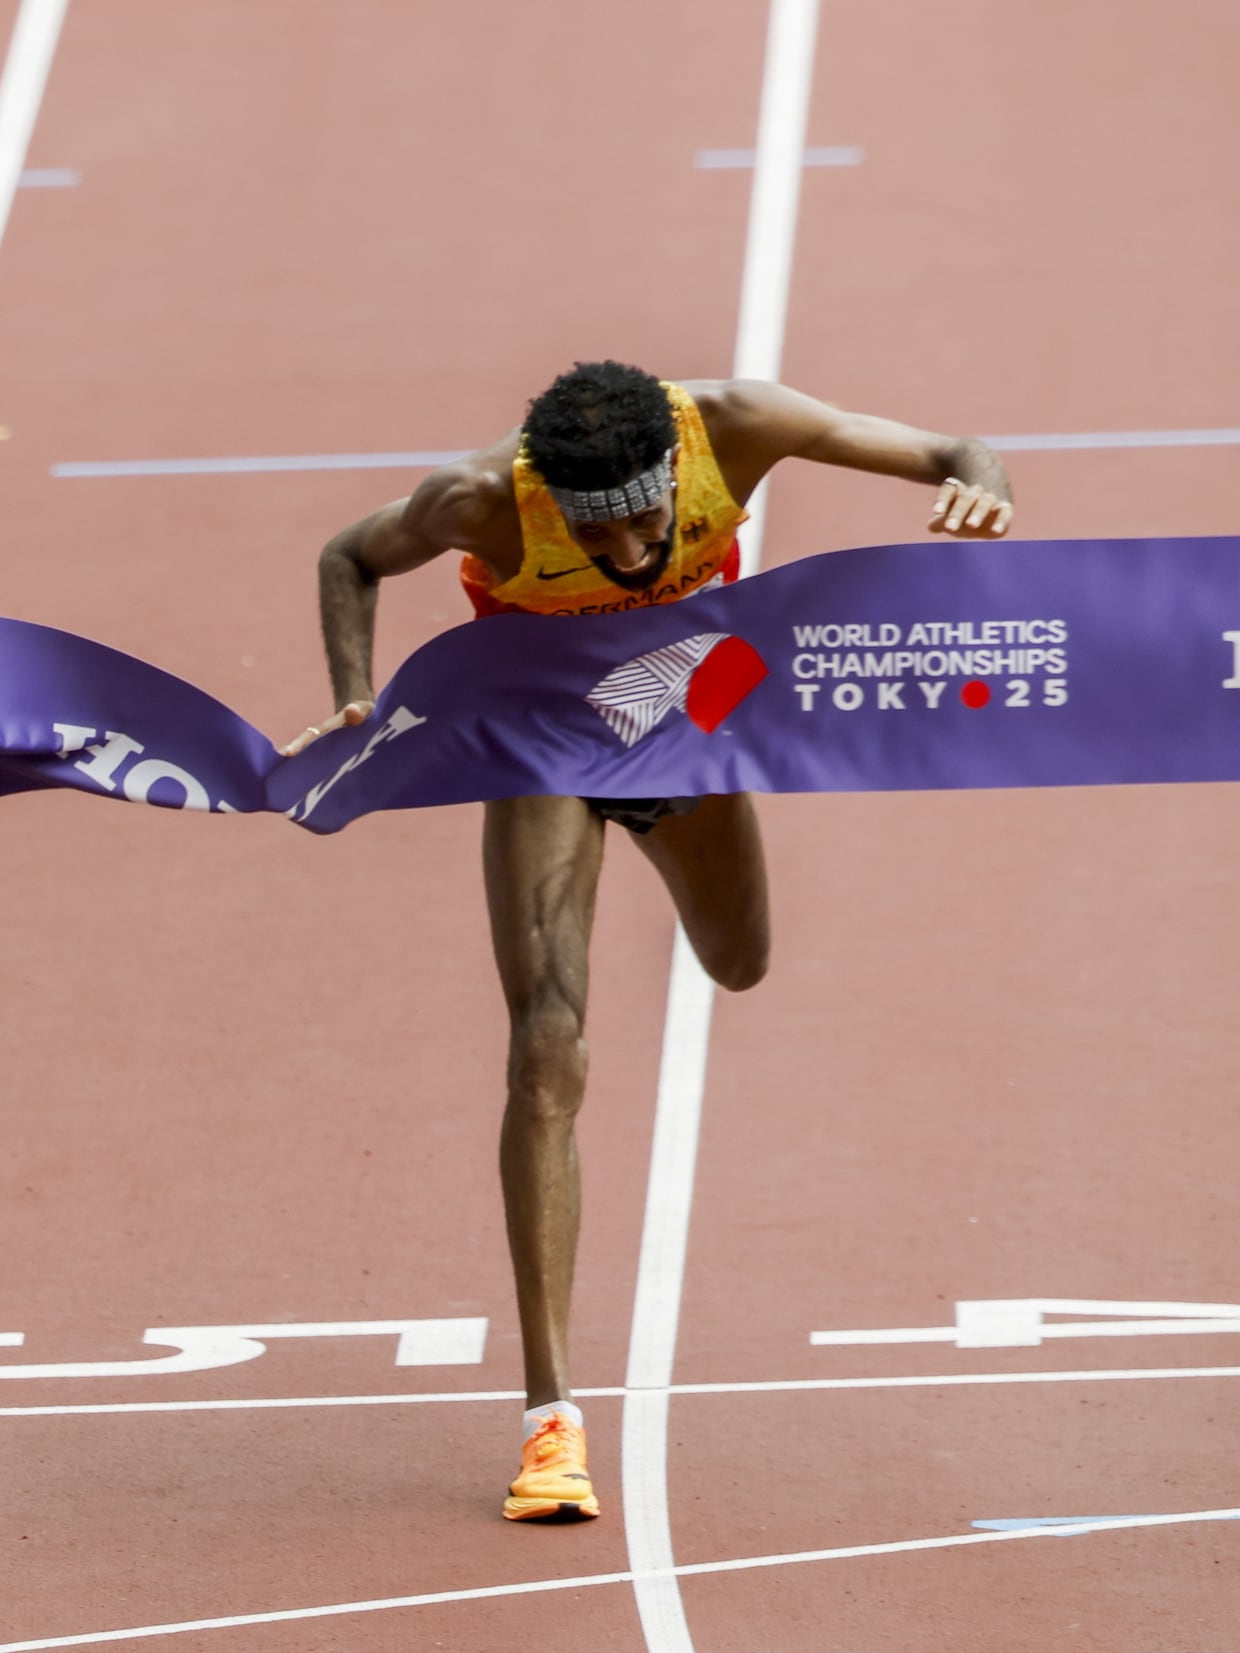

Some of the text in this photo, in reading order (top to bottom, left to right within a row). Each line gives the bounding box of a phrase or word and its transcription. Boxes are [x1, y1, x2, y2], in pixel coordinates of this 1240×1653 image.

[793, 619, 1068, 648] WORLD ATHLETICS
[792, 648, 1068, 679] CHAMPIONSHIPS
[53, 722, 239, 813] HO
